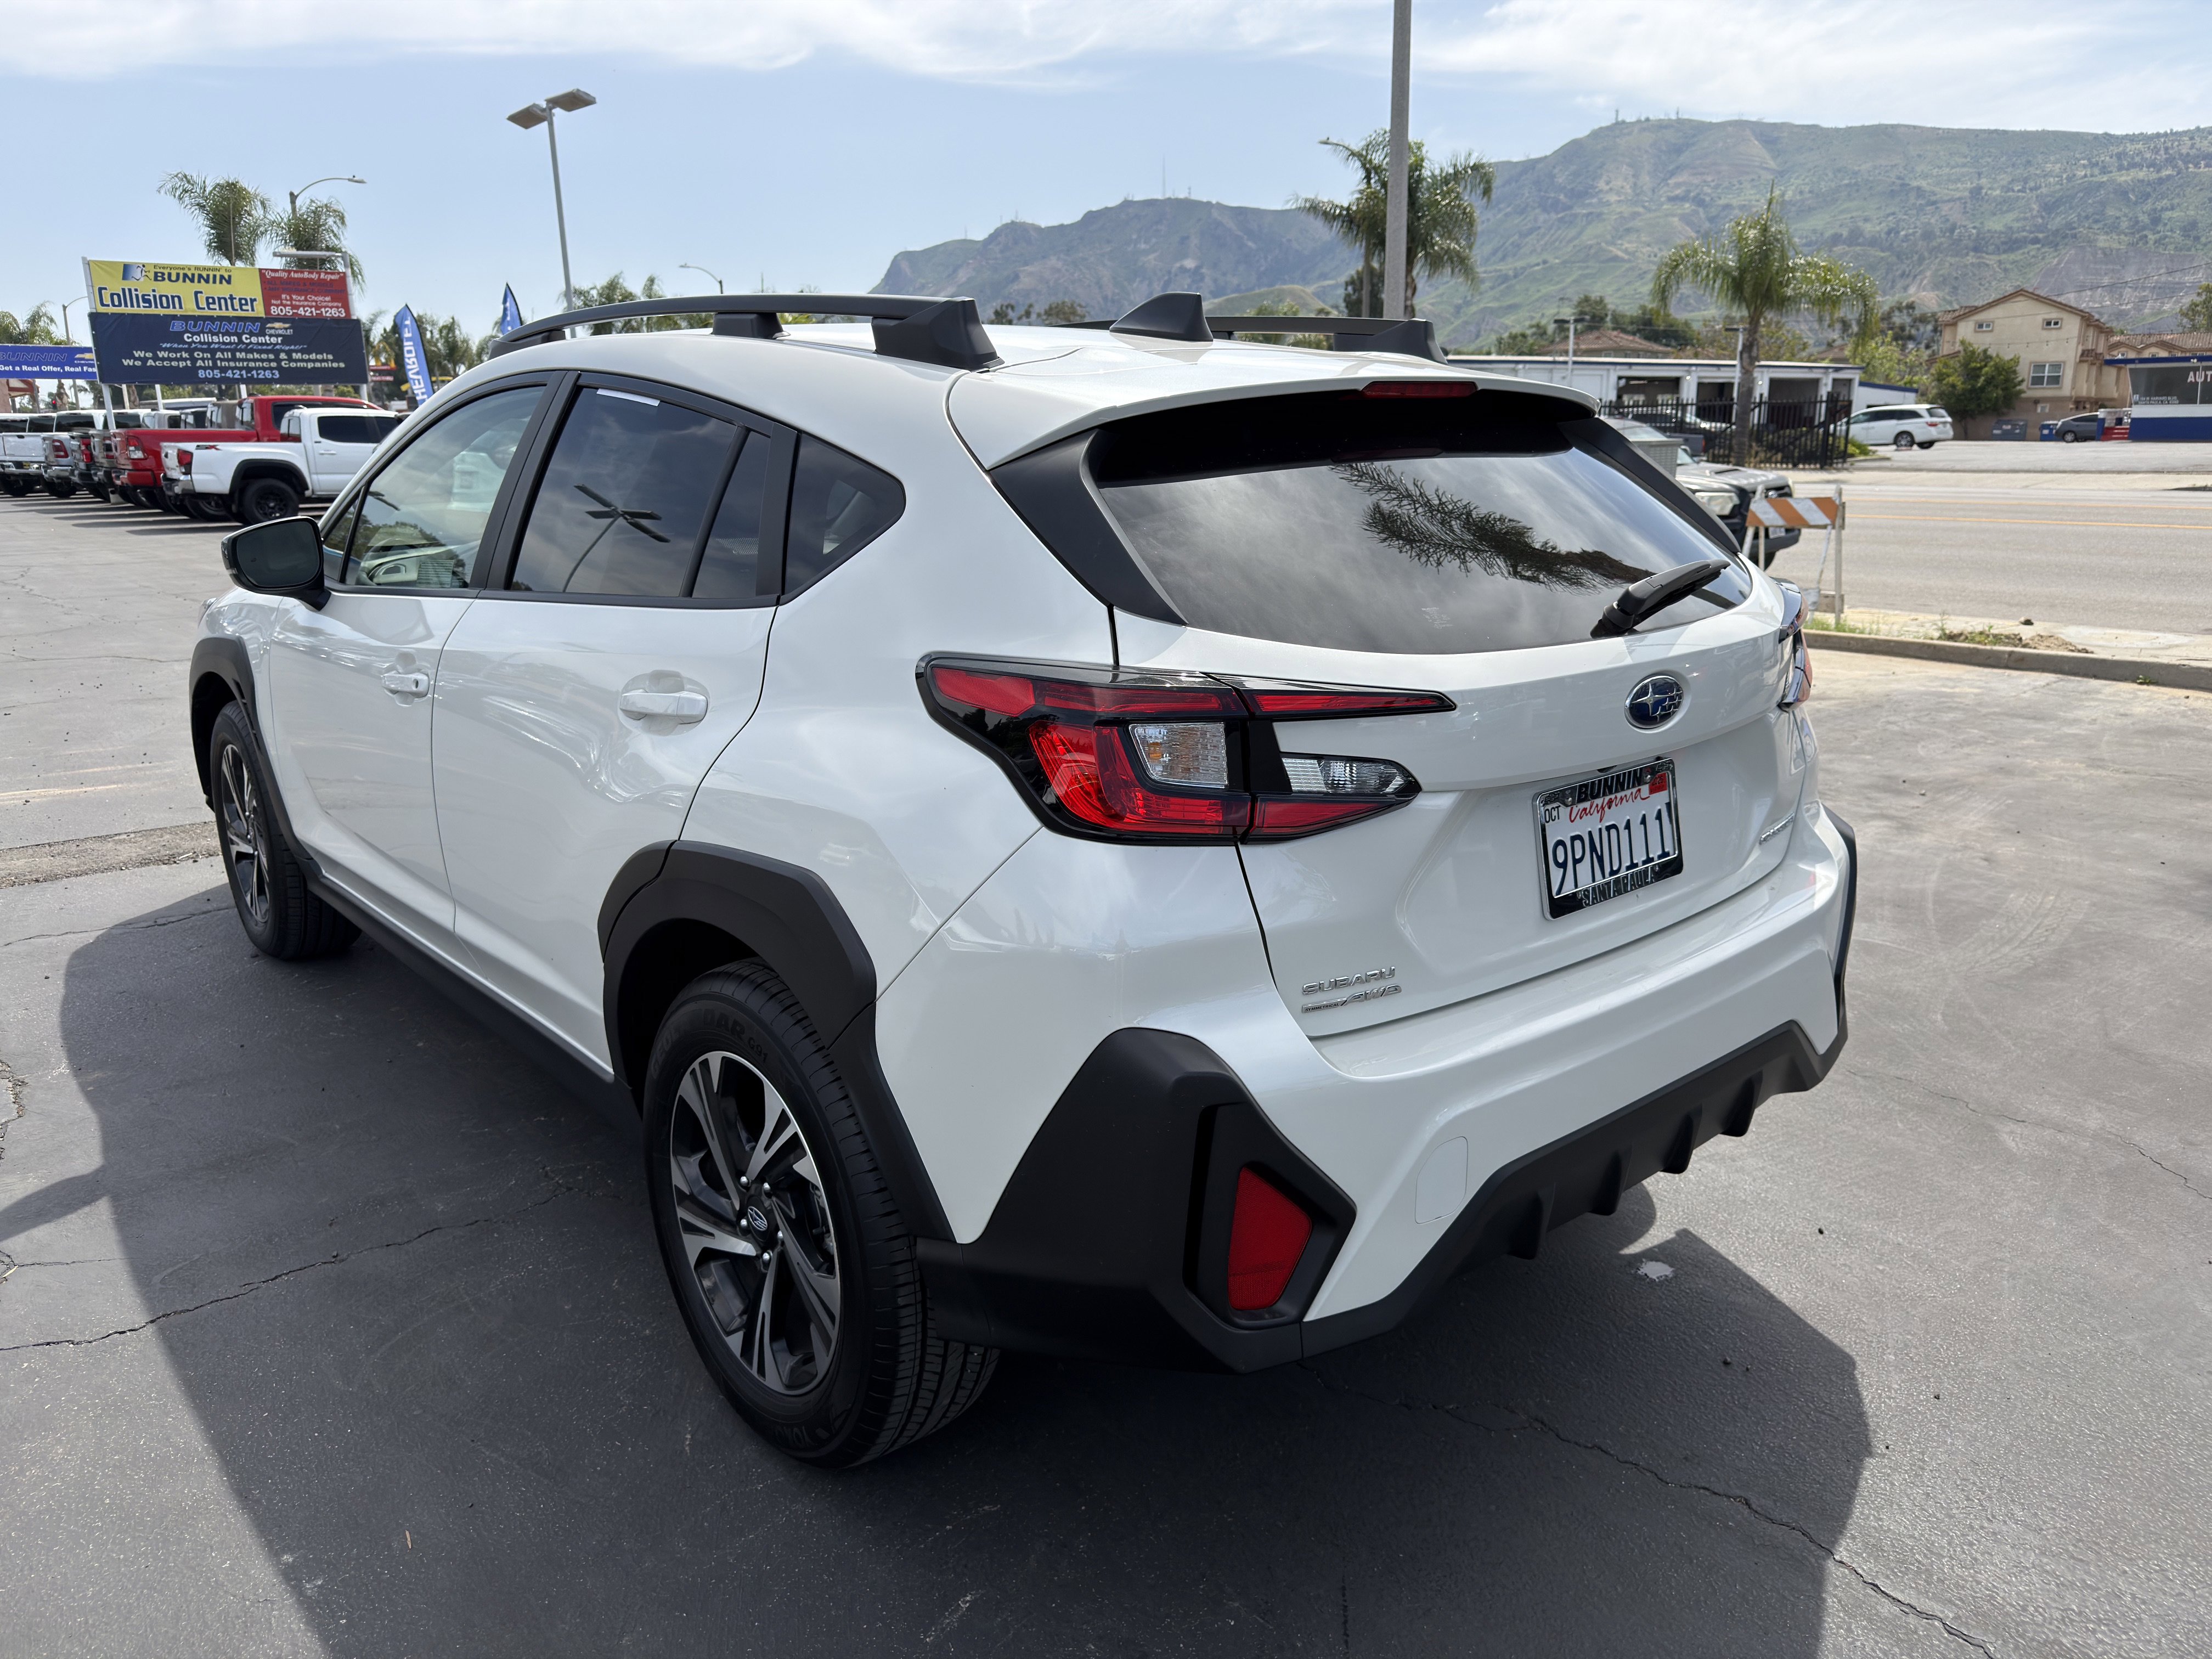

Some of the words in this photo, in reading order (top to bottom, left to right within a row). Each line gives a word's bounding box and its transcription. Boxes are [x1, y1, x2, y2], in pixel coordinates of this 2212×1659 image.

[153, 271, 232, 285] BUNNIN
[289, 271, 319, 280] AutoBody
[97, 286, 184, 311] Collision
[193, 290, 257, 312] Center
[270, 306, 346, 317] 805-421-1263
[170, 320, 261, 333] BUNNIN
[184, 332, 238, 342] Collision
[242, 334, 283, 344] Center
[146, 359, 192, 368] Accept
[281, 360, 345, 369] Companies
[198, 369, 280, 379] 805-421-1263
[1575, 767, 1643, 804] BUNNIN
[1544, 804, 1561, 823] OCT
[1569, 788, 1650, 823] California
[1551, 808, 1670, 896] 9PND111
[1302, 966, 1396, 995] SUBARU
[1304, 1002, 1339, 1012] SYMMETRICAL
[1340, 983, 1402, 1006] AWD
[651, 1008, 746, 1079] GEOLDAR
[748, 1036, 769, 1063] G91
